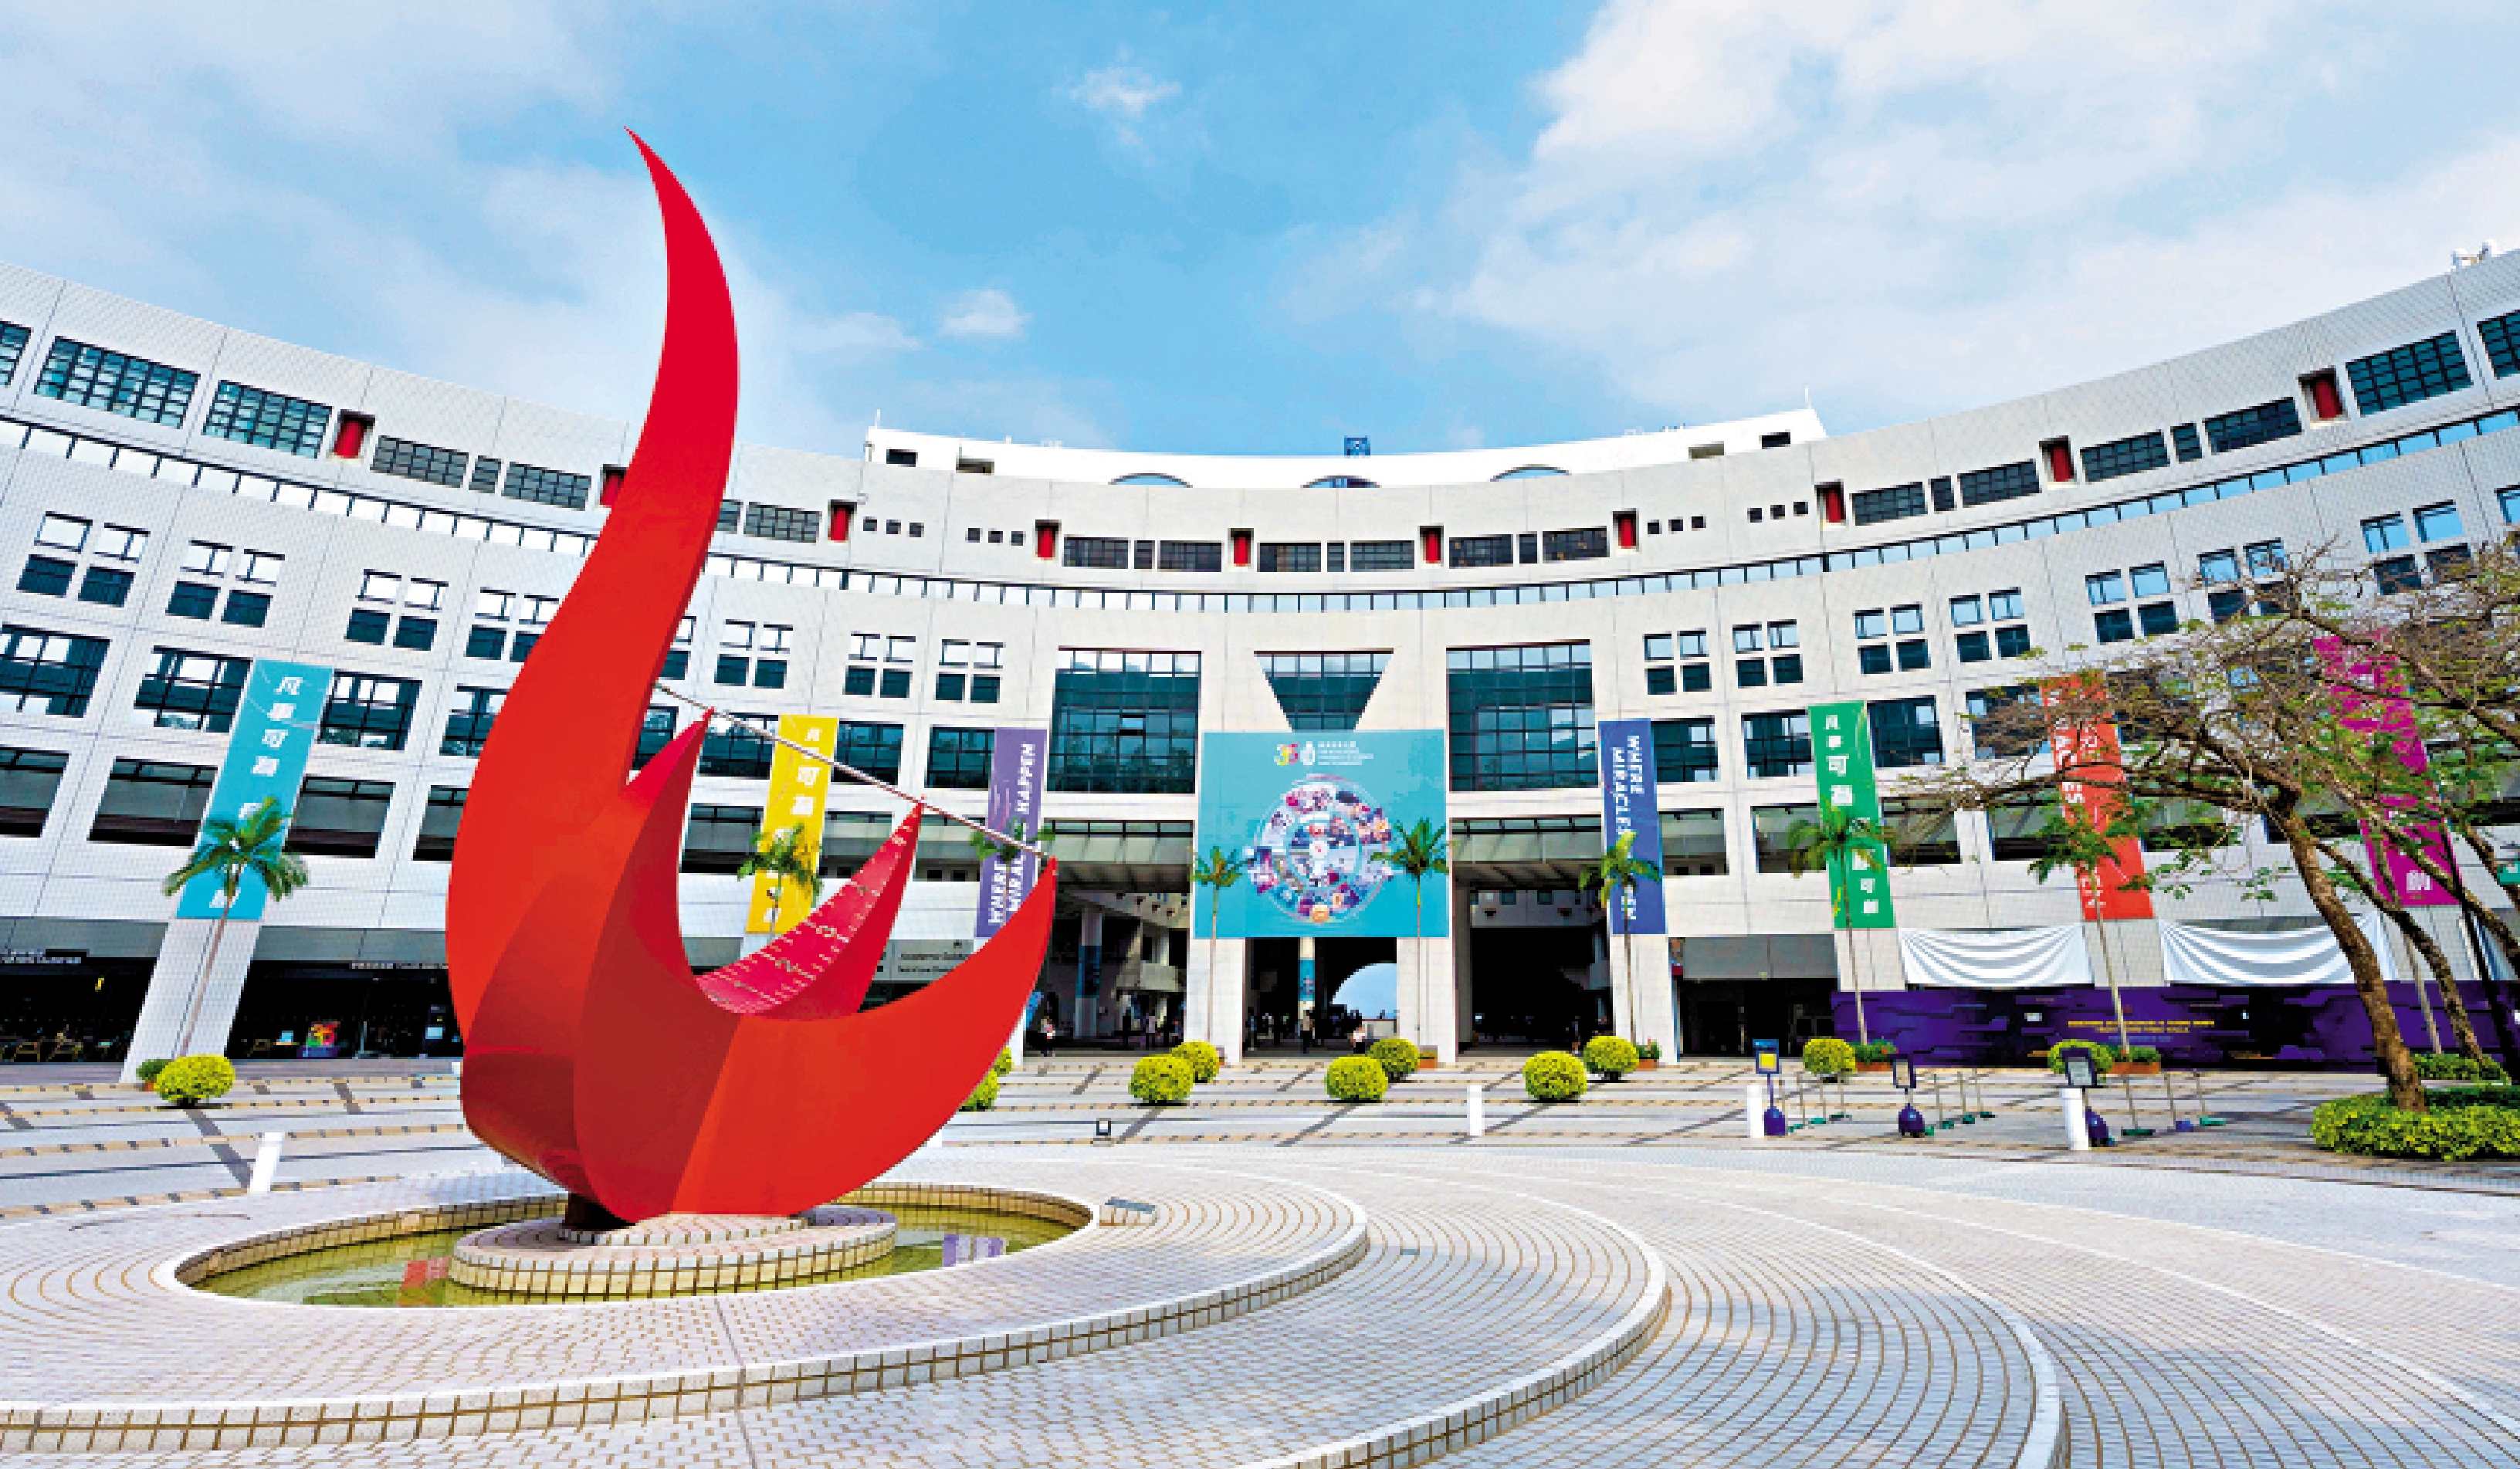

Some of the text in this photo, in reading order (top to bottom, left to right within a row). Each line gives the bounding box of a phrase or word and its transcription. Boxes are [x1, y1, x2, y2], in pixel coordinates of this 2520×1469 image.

[1015, 742, 1035, 814] HAPPEN
[1627, 734, 1645, 795] WHERE
[305, 1022, 340, 1048] 35
